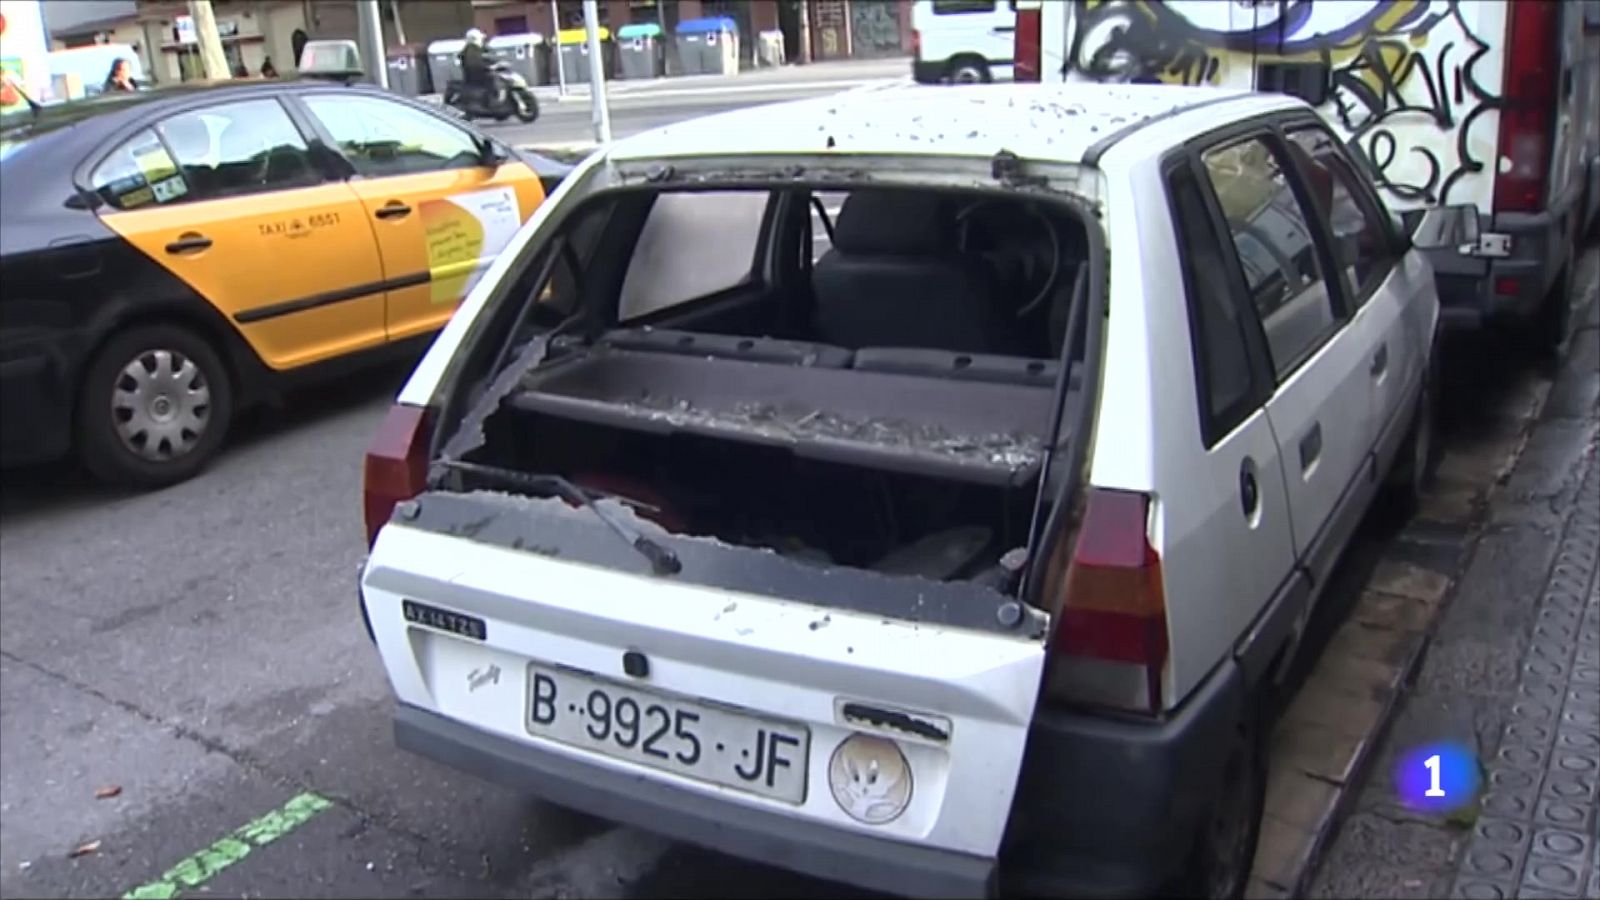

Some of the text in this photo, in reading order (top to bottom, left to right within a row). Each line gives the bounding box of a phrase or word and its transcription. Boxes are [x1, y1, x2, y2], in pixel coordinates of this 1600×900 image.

[258, 221, 287, 236] TAXI
[531, 672, 558, 726] B
[586, 689, 701, 766] 9925
[734, 728, 800, 788] JF
